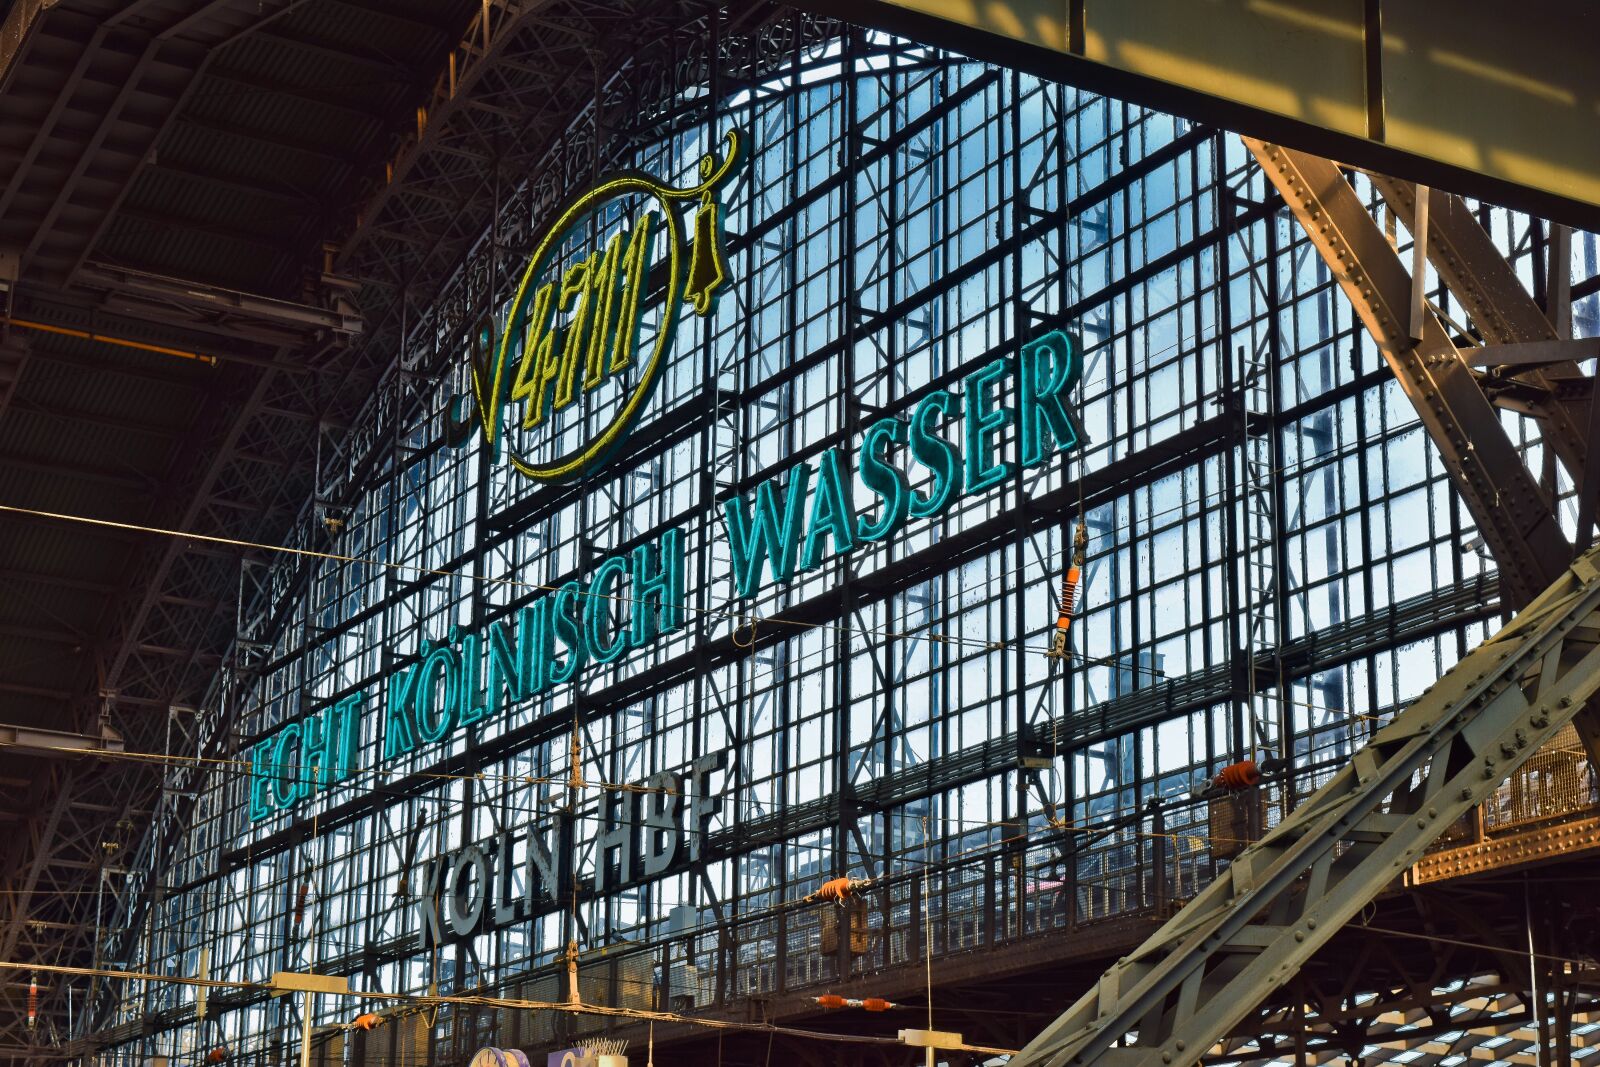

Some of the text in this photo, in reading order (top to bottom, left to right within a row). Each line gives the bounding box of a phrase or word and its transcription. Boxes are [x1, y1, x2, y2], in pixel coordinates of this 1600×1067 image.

[511, 212, 655, 430] 4711
[249, 329, 1088, 822] ECHT KÖLNISCH WASSER
[418, 750, 728, 949] KÖLN HBF
